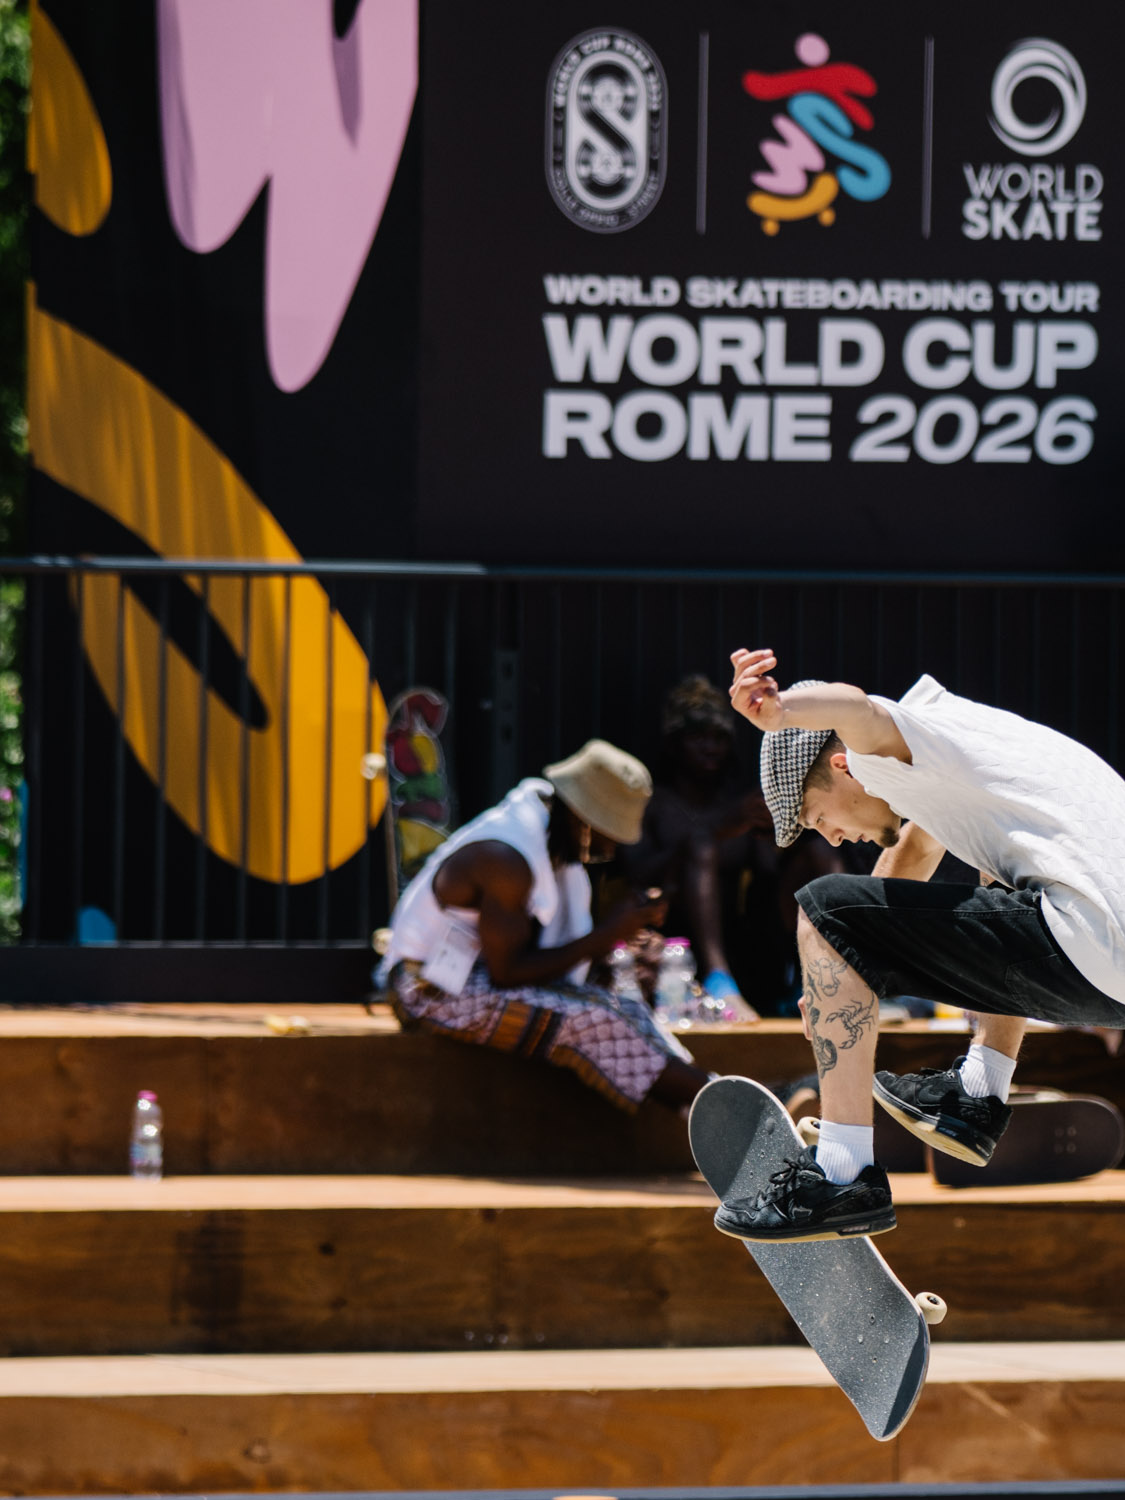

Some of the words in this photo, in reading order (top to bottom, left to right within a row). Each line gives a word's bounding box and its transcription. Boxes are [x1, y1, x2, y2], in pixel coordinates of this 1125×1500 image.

[964, 164, 1103, 200] WORLD
[963, 201, 1102, 241] SKATE
[544, 275, 681, 307] WORLD
[687, 277, 993, 311] SKATEBOARDING
[1001, 282, 1100, 312] TOUR
[542, 315, 885, 386] WORLD
[903, 319, 1099, 389] CUP
[542, 391, 832, 461] ROME
[849, 396, 1097, 464] 2026
